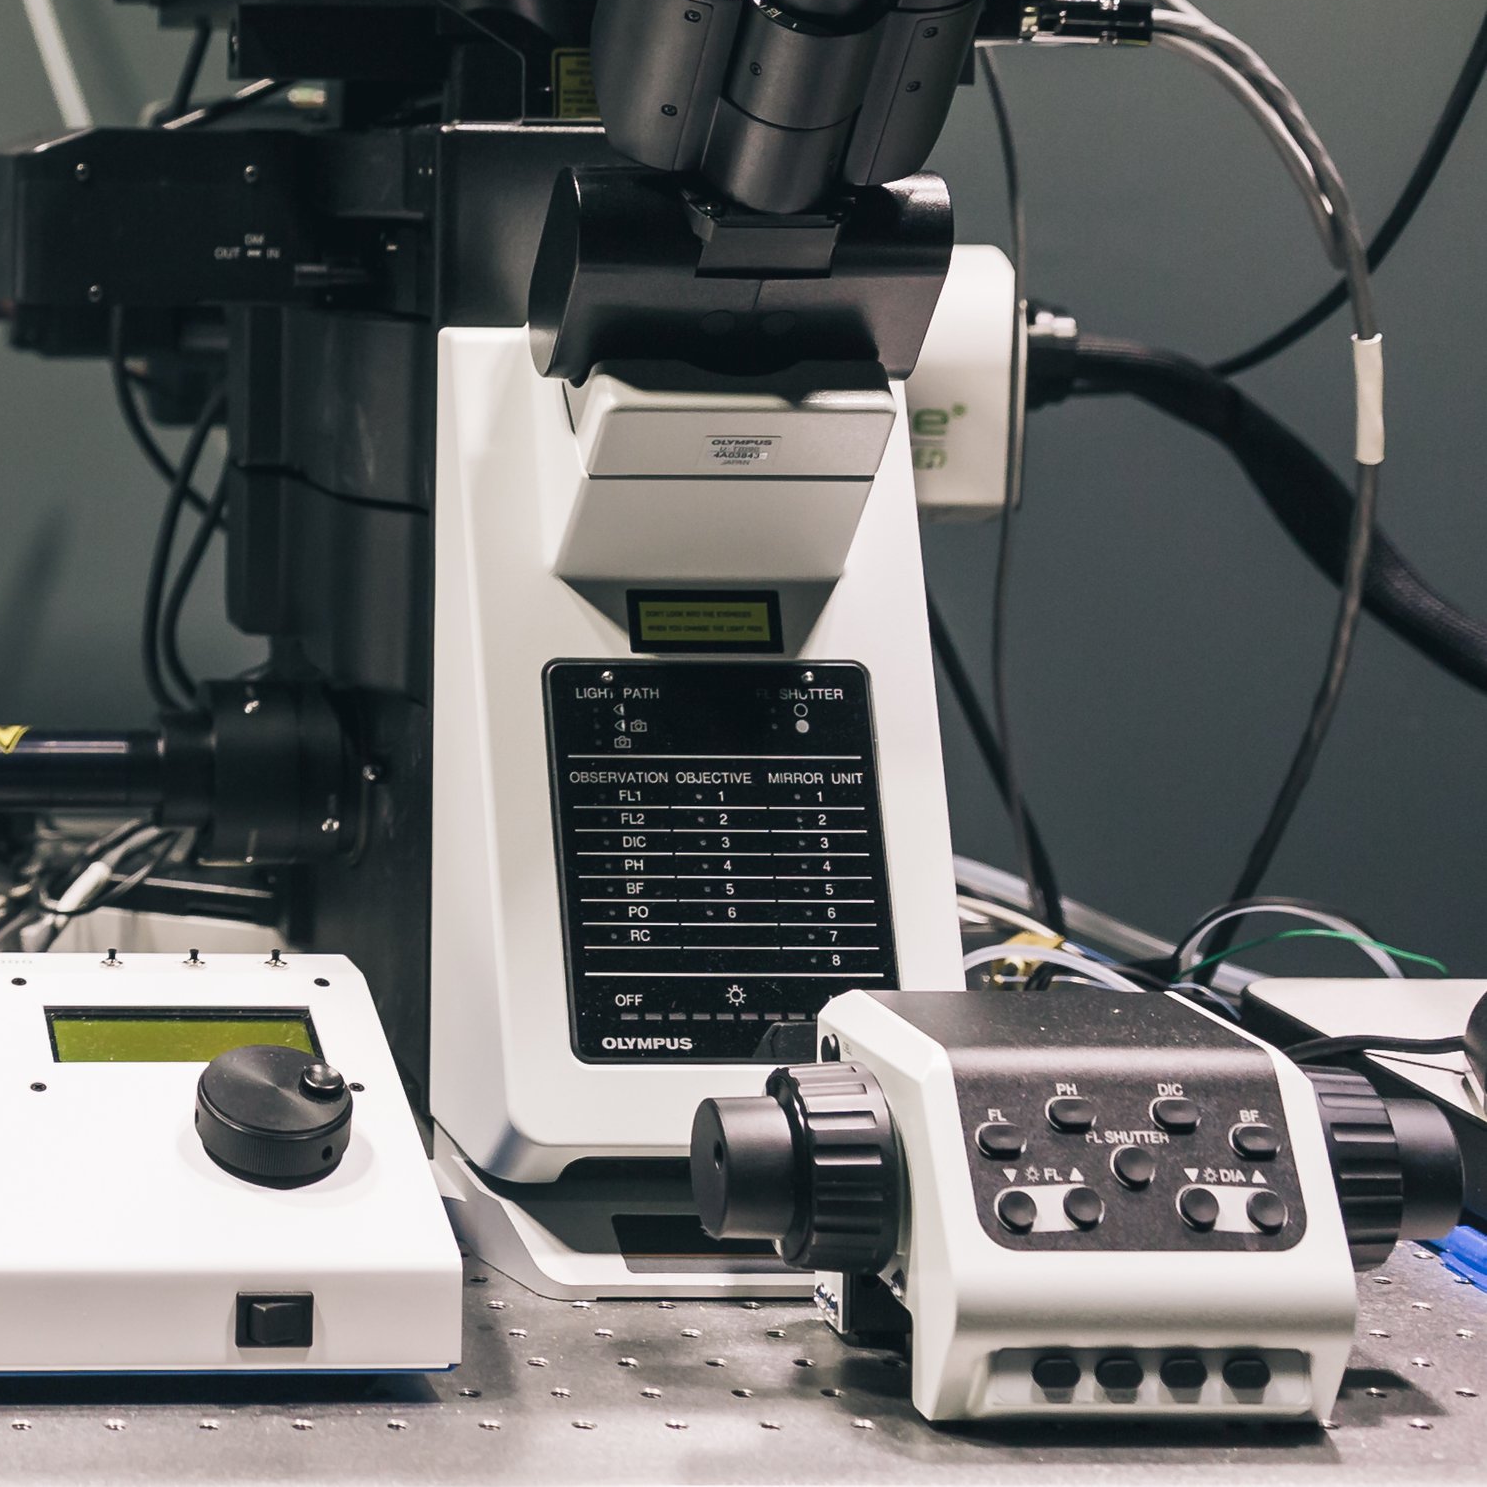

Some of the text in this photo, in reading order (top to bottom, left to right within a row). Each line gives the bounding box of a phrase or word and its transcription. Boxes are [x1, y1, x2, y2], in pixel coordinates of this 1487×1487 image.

[214, 247, 241, 259] OUT
[624, 689, 659, 699] PATH
[779, 689, 843, 700] SHUTTER
[570, 772, 668, 783] OBSERVATION
[676, 772, 752, 784] OBJECTIVE
[768, 772, 863, 784] MIRROR UNIT
[619, 790, 640, 801] FL1
[719, 791, 723, 801] 1
[817, 792, 822, 801] 1
[621, 813, 644, 824] FL2
[720, 814, 727, 825] 2
[818, 814, 826, 825] 2
[623, 836, 646, 847] DIC
[722, 837, 730, 848] 3
[821, 837, 828, 848] 3
[625, 859, 643, 870] PH
[724, 860, 731, 870] 4
[823, 861, 831, 871] 4
[627, 883, 644, 894] BF
[726, 883, 734, 895] 5
[826, 884, 833, 895] 5
[629, 906, 648, 918] PO
[728, 907, 736, 918] 6
[828, 907, 836, 919] 6
[631, 930, 650, 941] RC
[830, 931, 837, 941] 7
[832, 955, 840, 966] 8
[615, 994, 643, 1006] OFF
[602, 1037, 692, 1050] OLYMPUS
[1056, 1084, 1077, 1095] PH
[1158, 1084, 1183, 1096] DIC
[988, 1109, 1007, 1121] FL
[1240, 1110, 1259, 1122] BF
[1086, 1131, 1169, 1144] FL SHUTTER
[1045, 1169, 1062, 1181] FL
[1220, 1170, 1246, 1182] DIA
